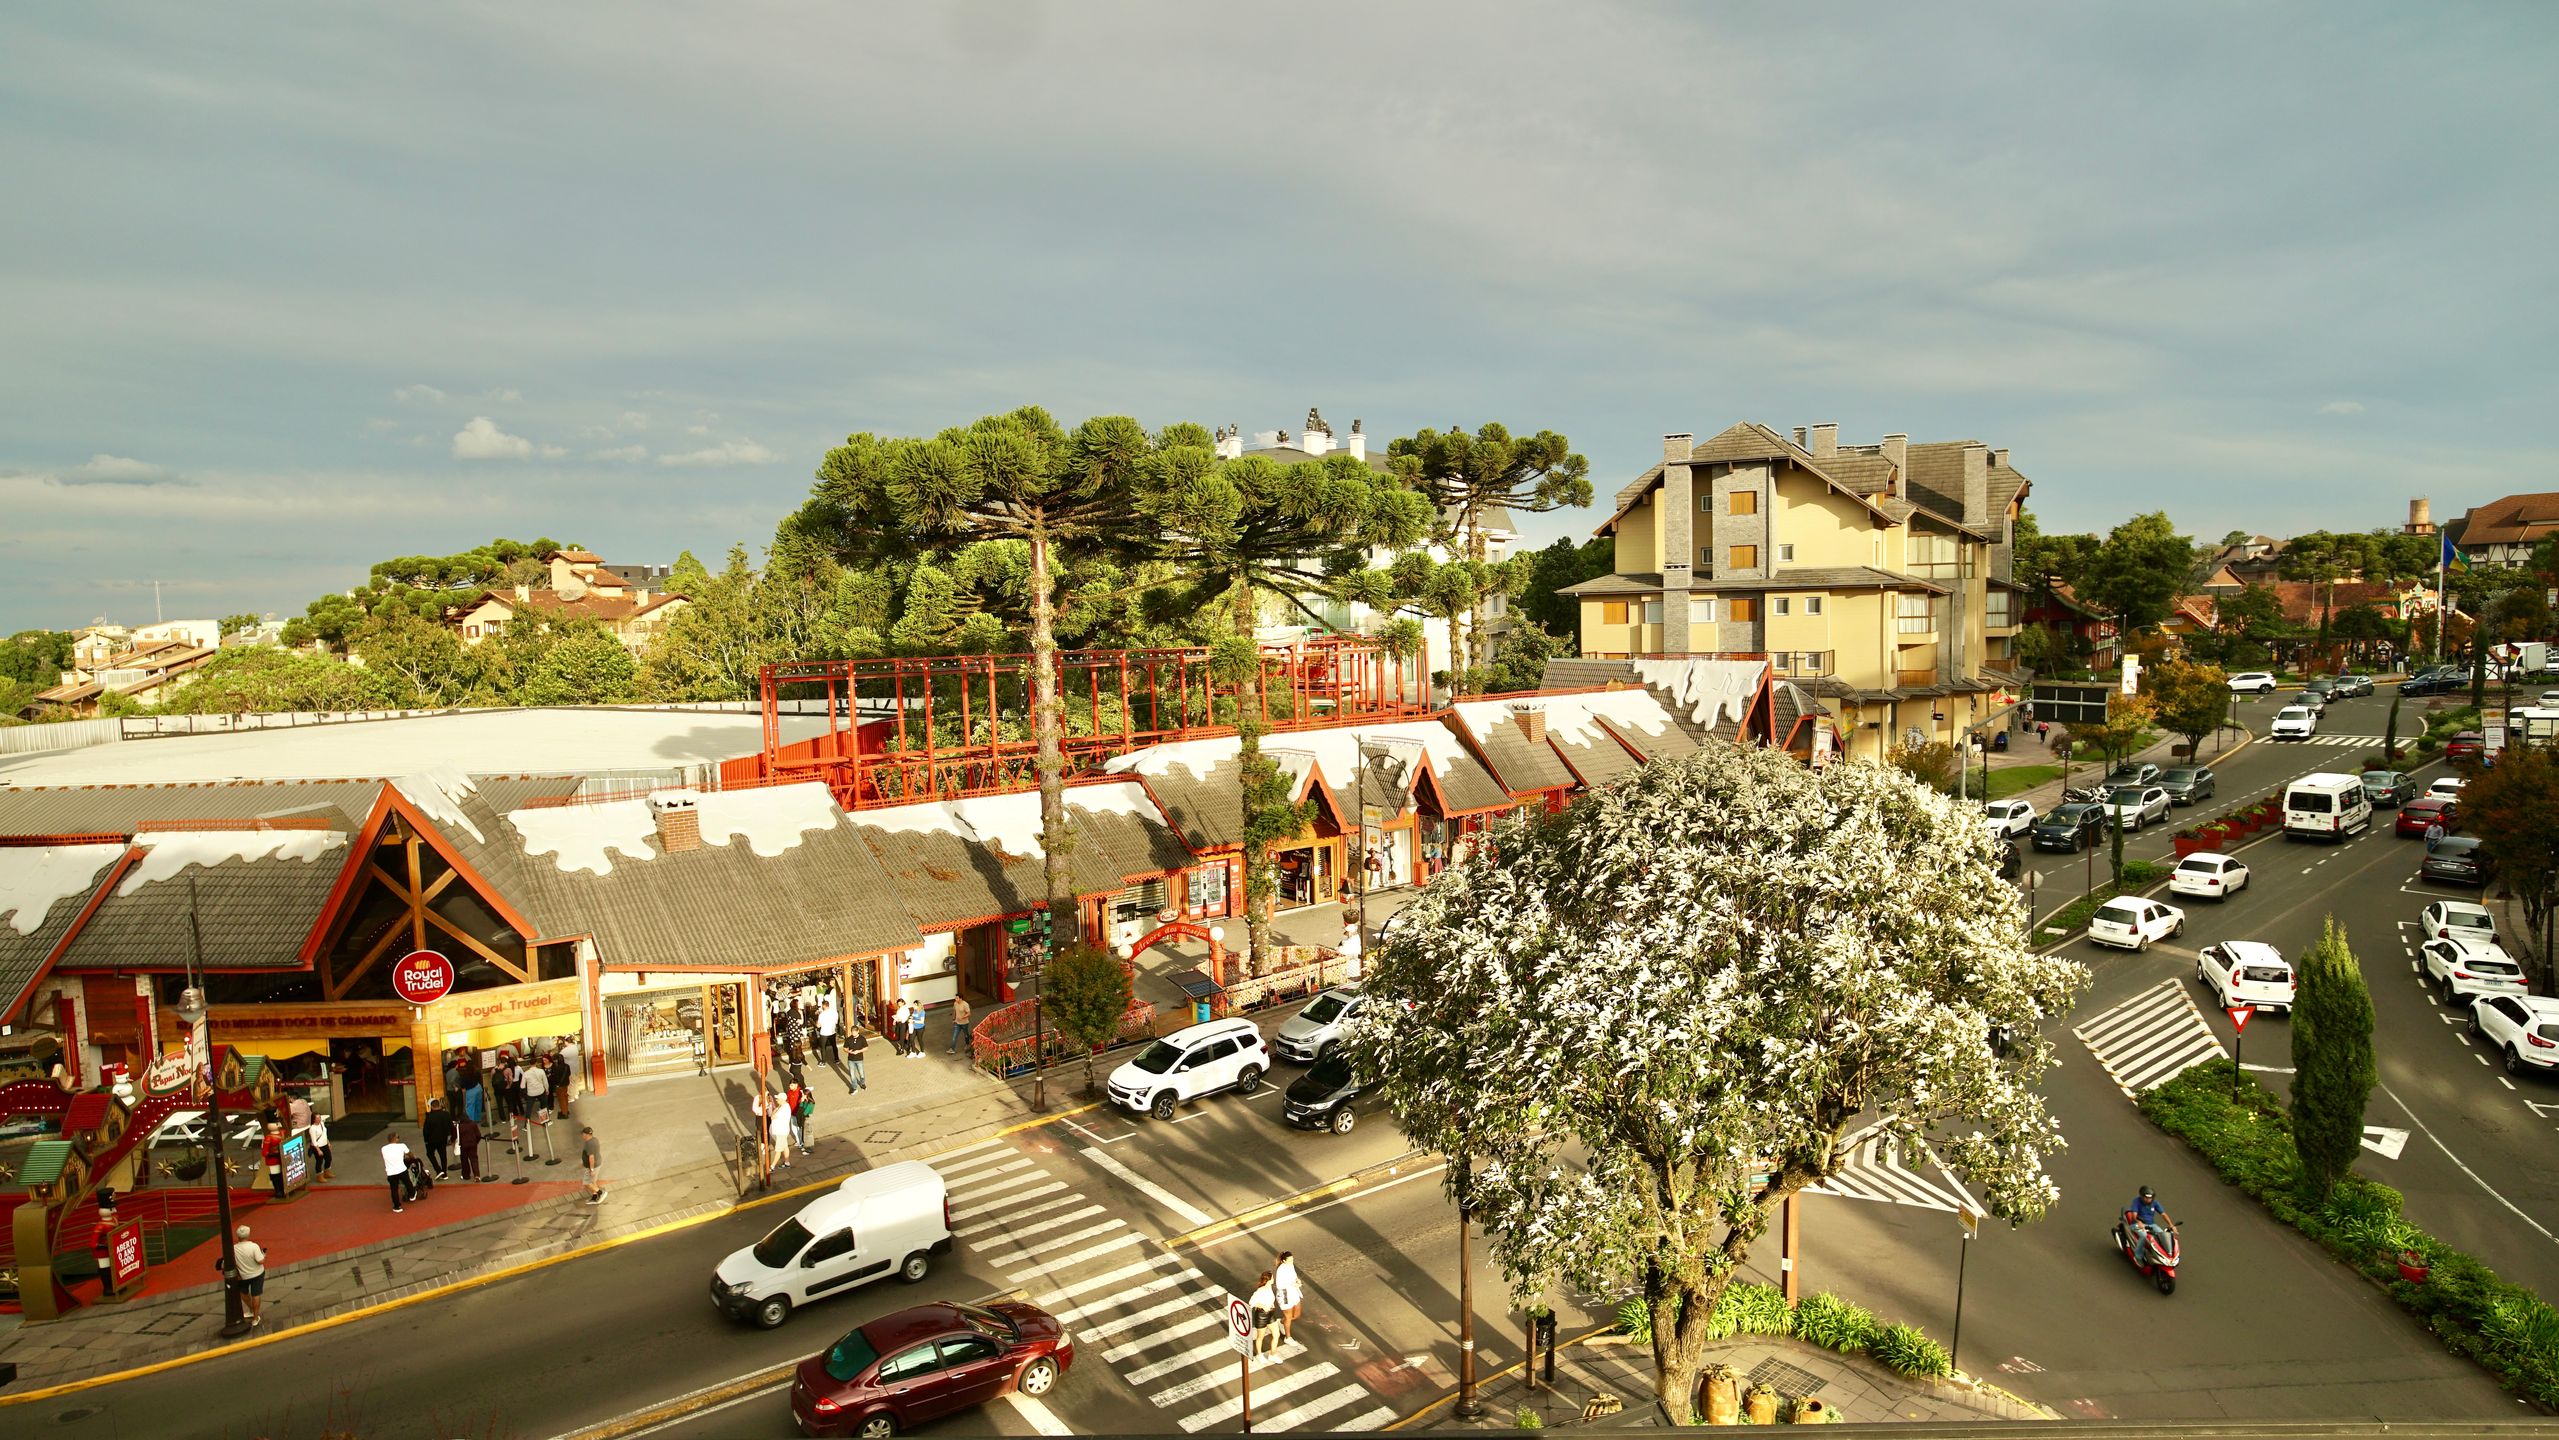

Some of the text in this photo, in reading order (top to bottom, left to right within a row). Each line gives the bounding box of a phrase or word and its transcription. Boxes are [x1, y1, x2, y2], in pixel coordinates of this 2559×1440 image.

[1181, 926, 1207, 938] Desejos
[404, 966, 443, 982] Royal
[405, 977, 444, 991] Trudel
[463, 994, 552, 1018] Royal Trudel
[284, 1017, 318, 1028] DOCE
[338, 1015, 397, 1026] GRAMADO
[152, 1073, 176, 1089] Papai
[117, 1237, 137, 1254] ABERTO
[121, 1253, 134, 1267] TODO
